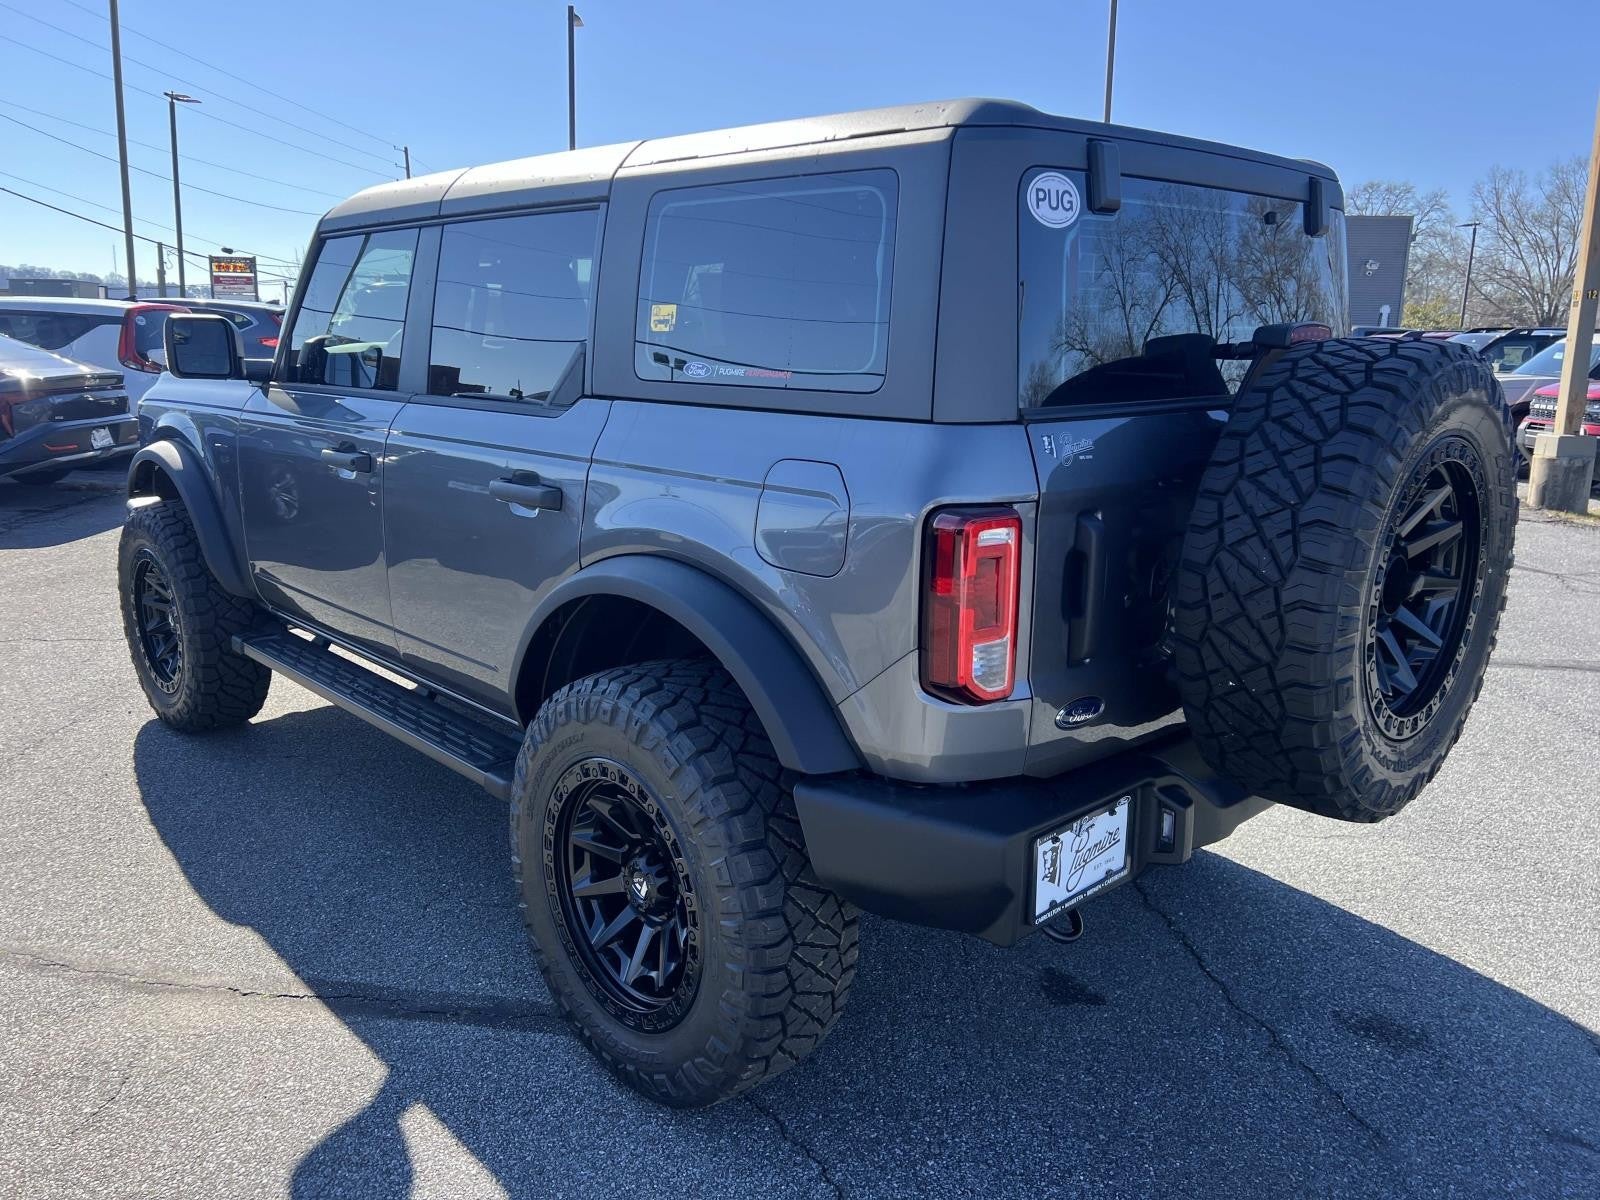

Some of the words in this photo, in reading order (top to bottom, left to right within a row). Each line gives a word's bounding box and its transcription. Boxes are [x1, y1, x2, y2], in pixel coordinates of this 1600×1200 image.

[1035, 187, 1074, 212] PUG
[1588, 290, 1598, 299] 12
[687, 362, 707, 376] Ford
[1066, 823, 1121, 893] Pugmire
